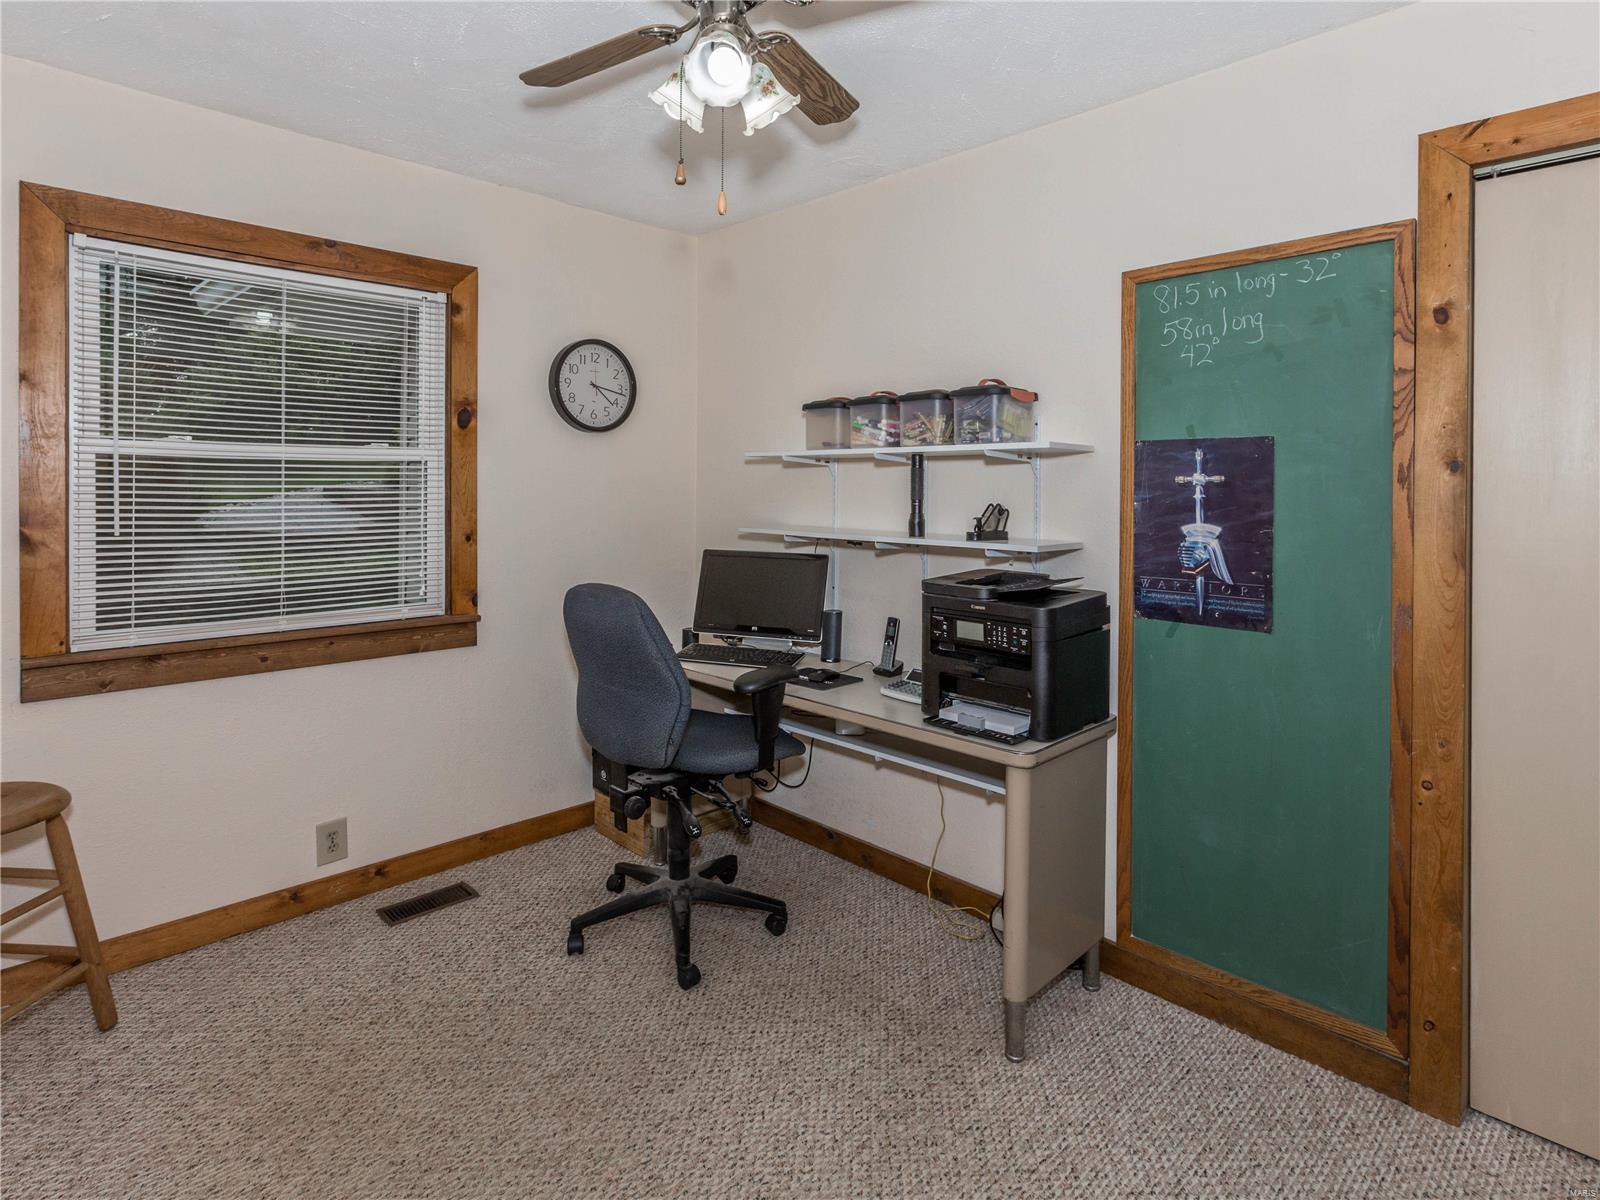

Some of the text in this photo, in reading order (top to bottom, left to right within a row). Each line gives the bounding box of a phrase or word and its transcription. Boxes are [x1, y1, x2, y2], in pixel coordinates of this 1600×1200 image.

[1153, 282, 1201, 314] 81.5
[1208, 280, 1227, 299] in
[1221, 306, 1265, 345] long
[579, 353, 587, 366] 11
[590, 352, 601, 364] 12
[568, 363, 579, 375] 10
[612, 368, 620, 380] 2
[564, 377, 572, 388] 9
[616, 383, 624, 395] 3
[568, 392, 576, 403] 8
[612, 397, 619, 408] 4
[578, 403, 585, 415] 7
[590, 409, 598, 420] 6
[603, 406, 610, 417] 5
